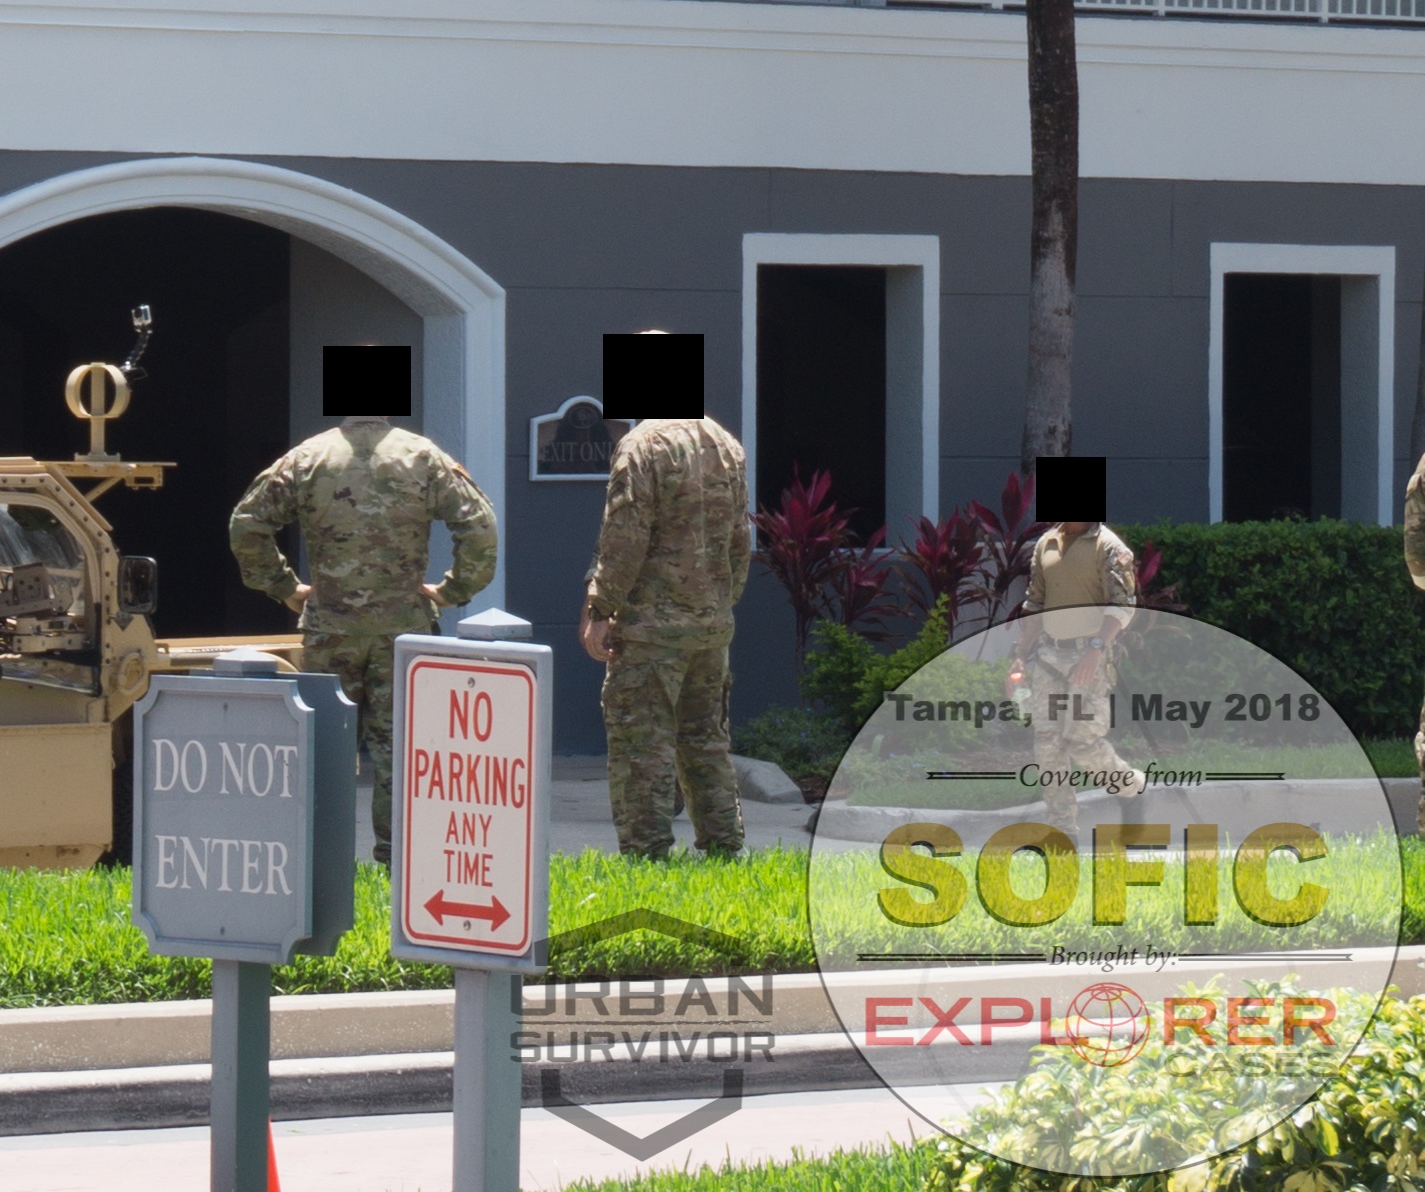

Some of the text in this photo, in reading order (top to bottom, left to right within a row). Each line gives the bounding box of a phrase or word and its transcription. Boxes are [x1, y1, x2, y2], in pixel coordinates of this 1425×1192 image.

[542, 441, 577, 462] EXIT
[449, 689, 493, 742] NO
[152, 738, 298, 798] DO NOT
[414, 748, 525, 809] PARKING
[445, 811, 492, 848] ANY
[154, 834, 293, 896] ENTER
[443, 849, 493, 887] TIME
